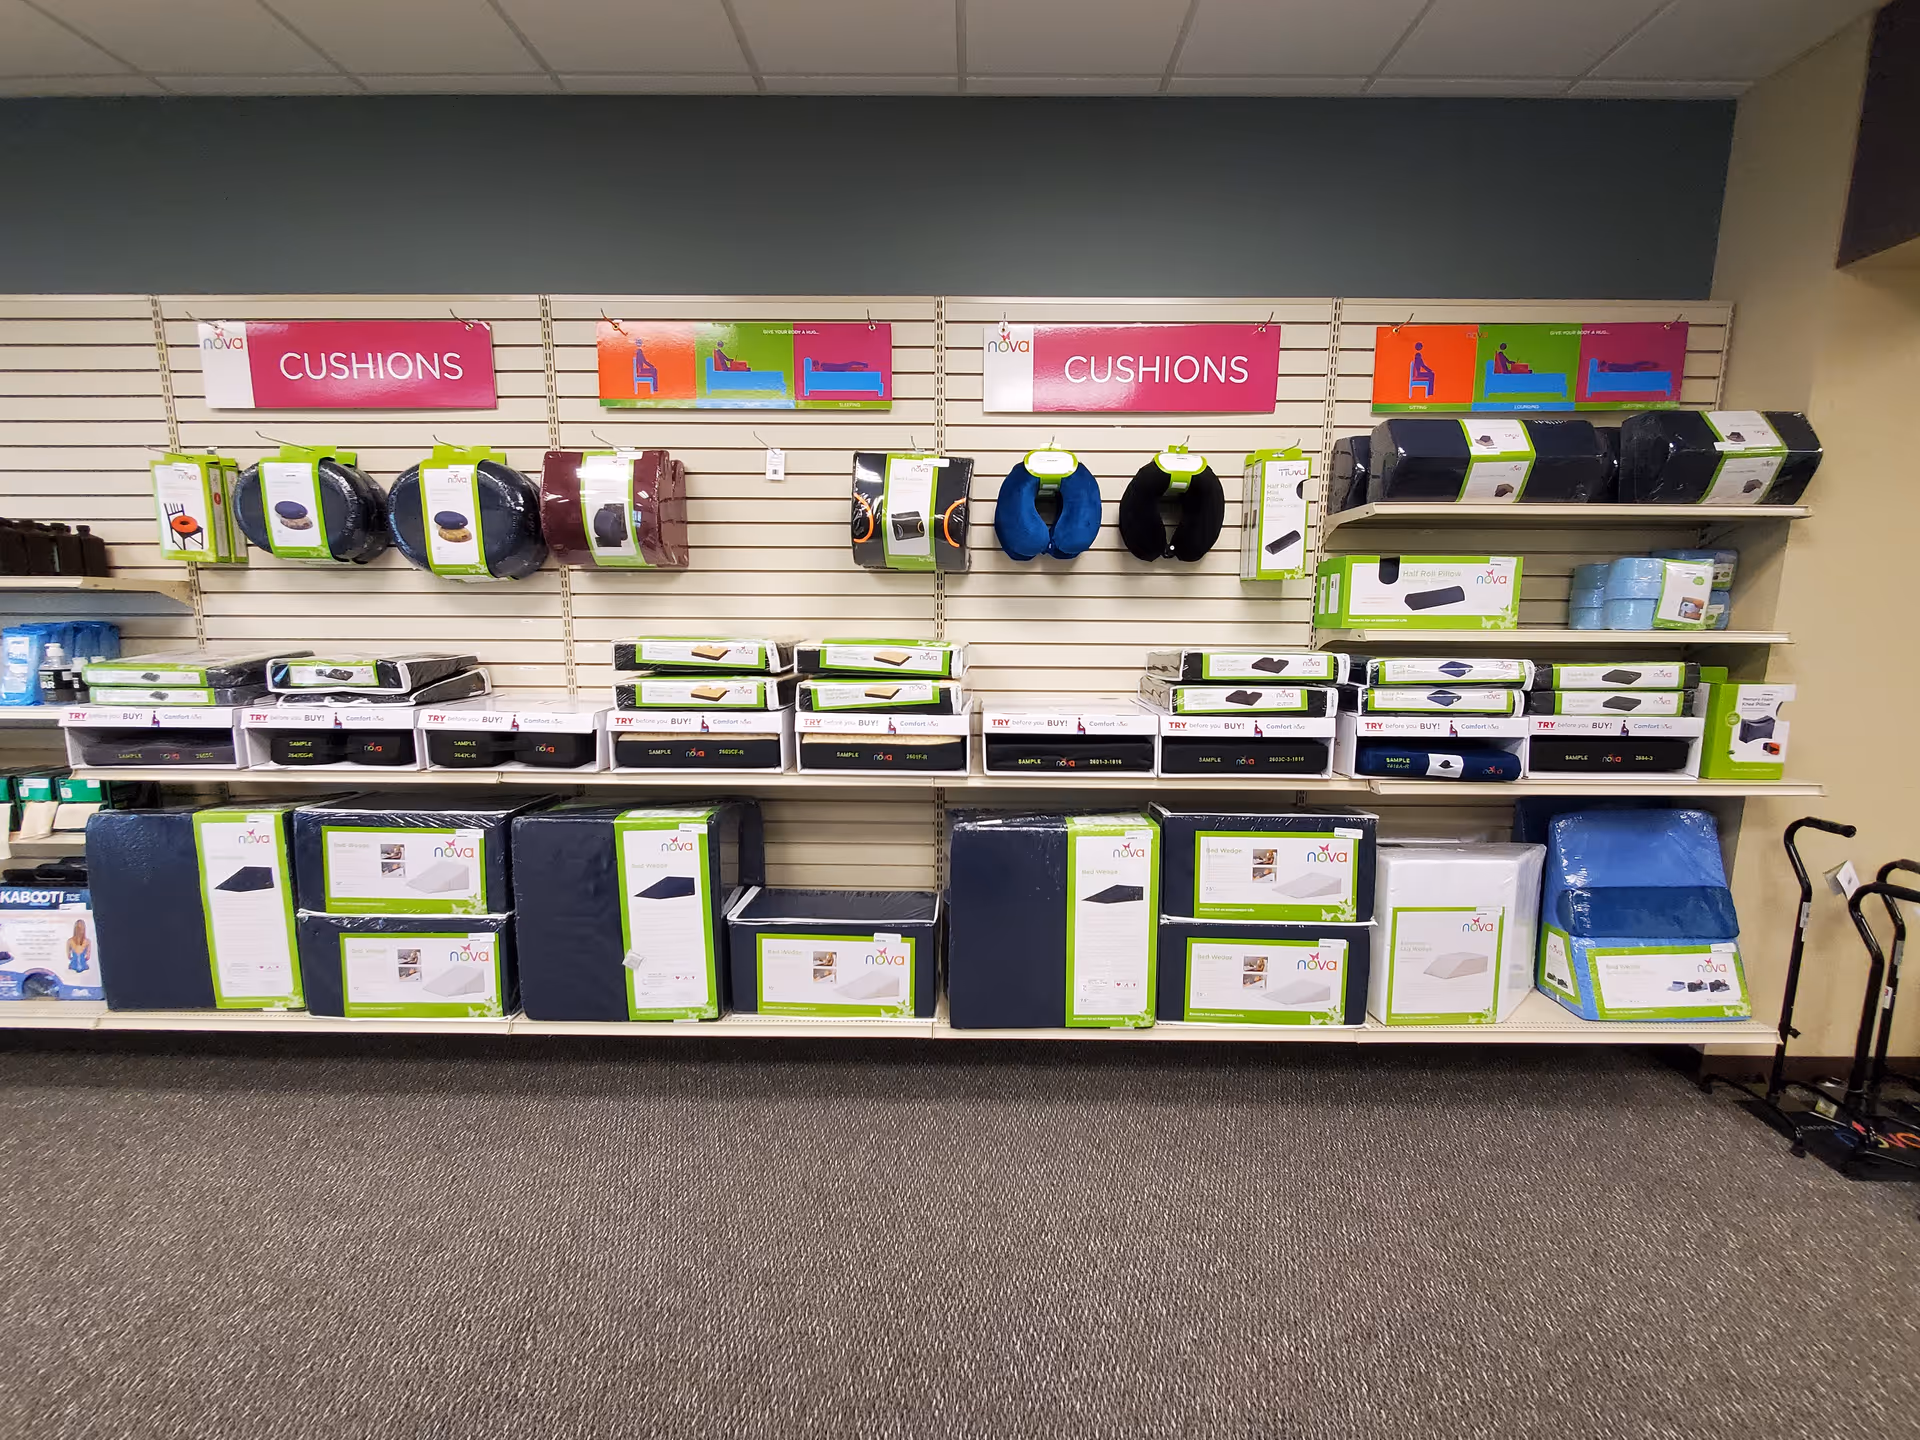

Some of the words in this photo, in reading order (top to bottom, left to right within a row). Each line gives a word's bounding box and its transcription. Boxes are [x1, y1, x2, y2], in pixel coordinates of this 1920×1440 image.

[204, 337, 244, 350] nova
[988, 340, 1030, 353] nova
[280, 352, 463, 380] CUSHIONS
[1064, 355, 1249, 384] CUSHIONS
[1476, 575, 1507, 584] nova
[535, 745, 555, 753] nova
[686, 749, 705, 757] nova
[238, 835, 270, 844] nova
[661, 842, 693, 851] nova
[434, 847, 474, 858] nova
[1113, 848, 1145, 858] nova
[1307, 851, 1348, 862] nova
[0, 891, 65, 904] KABOOTI
[1462, 923, 1494, 932] nova
[450, 951, 489, 962] nova
[865, 954, 905, 965] nova
[1297, 959, 1337, 971] nova
[1697, 964, 1727, 973] nova
